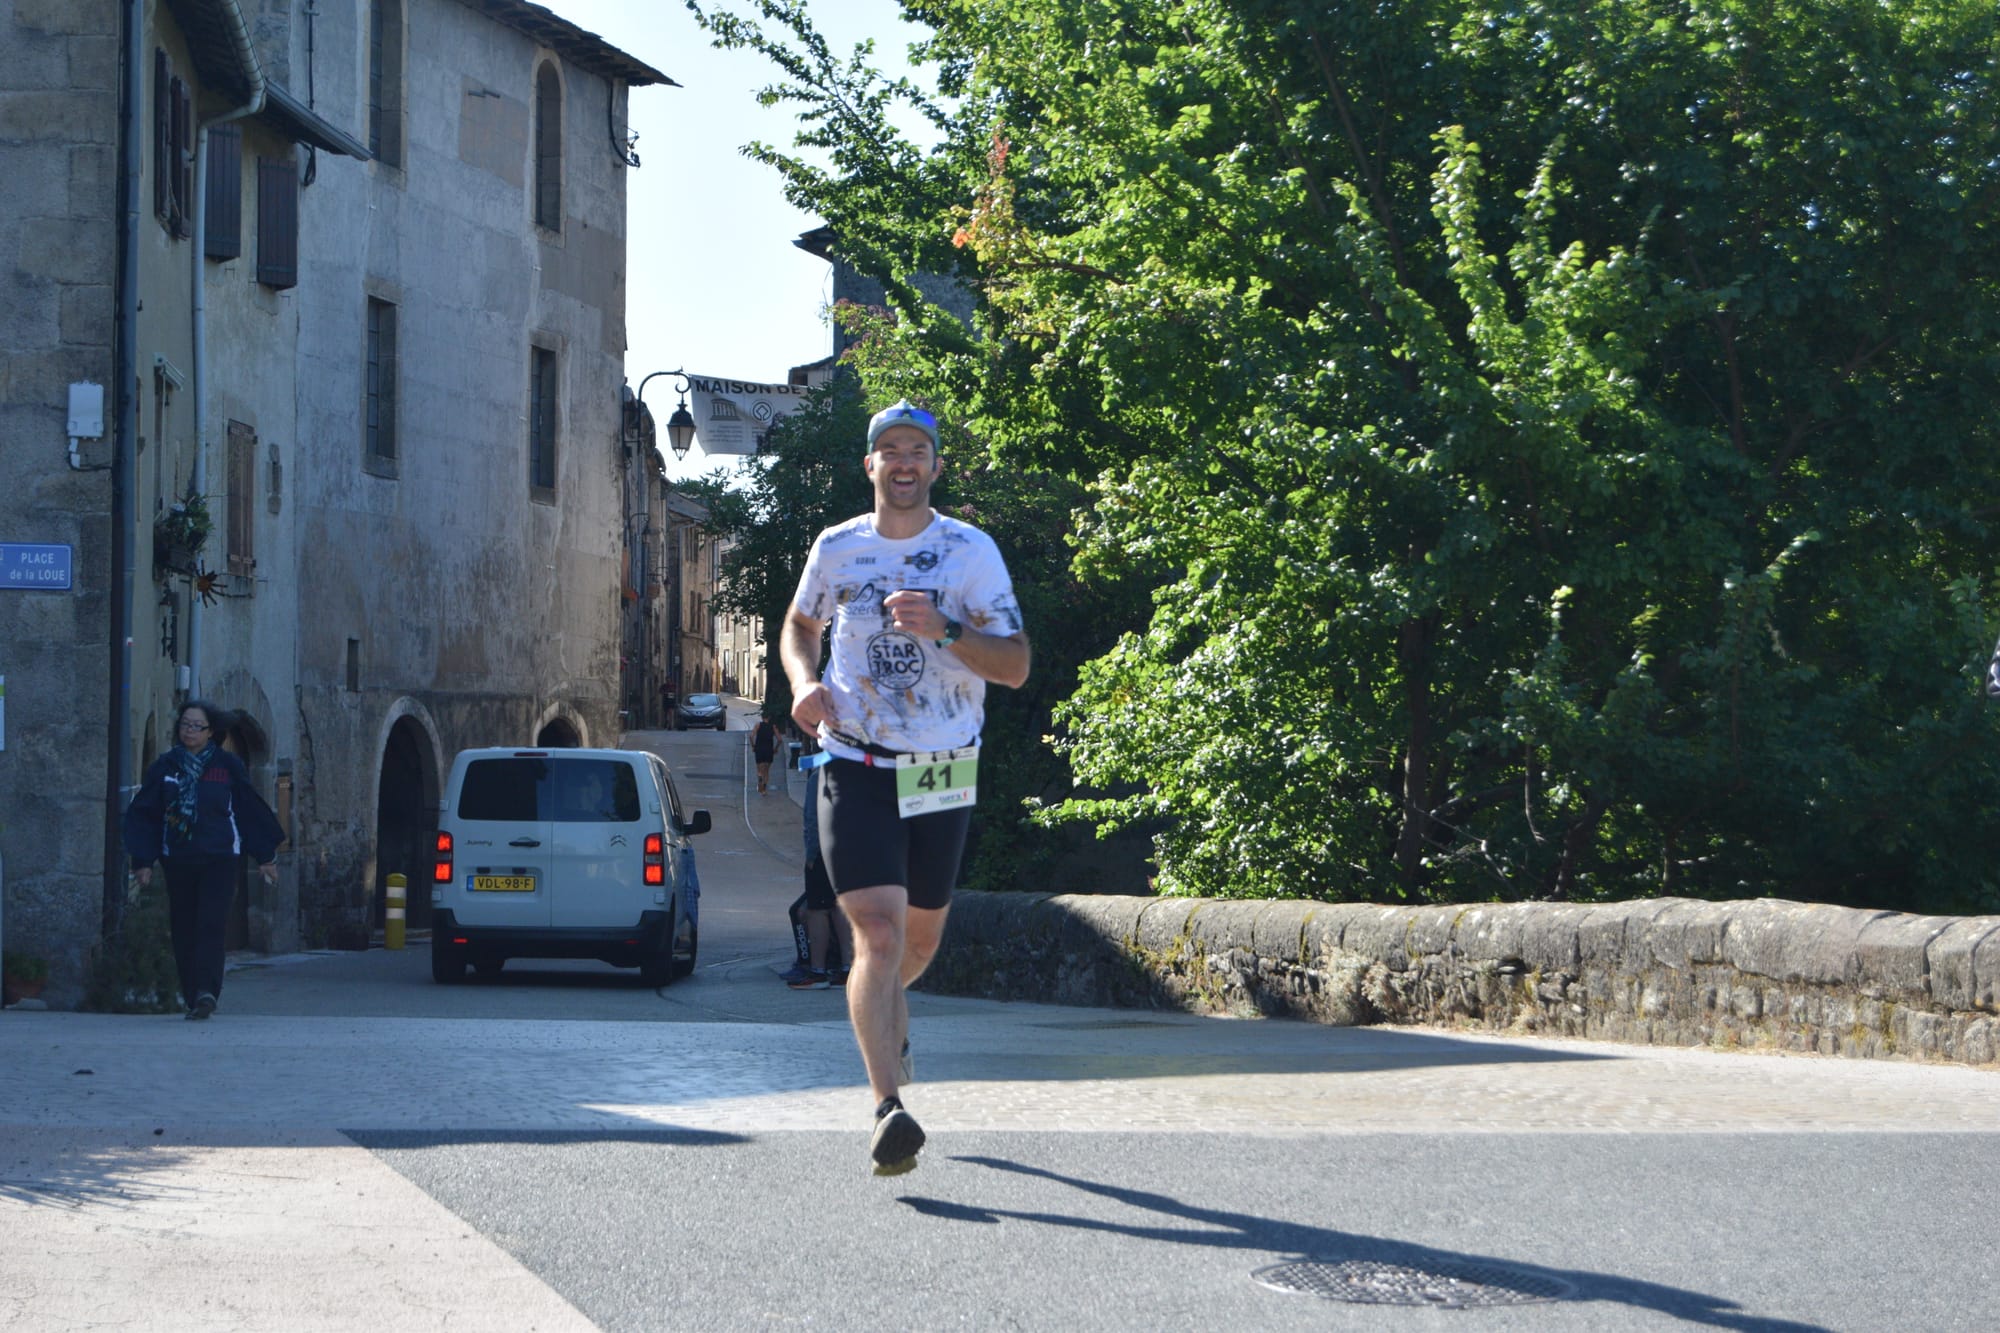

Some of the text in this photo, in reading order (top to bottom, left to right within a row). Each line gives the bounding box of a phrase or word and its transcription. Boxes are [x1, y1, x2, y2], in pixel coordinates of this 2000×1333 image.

[696, 380, 771, 394] MAISON
[777, 385, 801, 395] DE
[21, 552, 54, 564] PLACE
[10, 569, 65, 580] de la LOUE
[872, 643, 917, 658] STAR
[872, 660, 920, 674] TROC
[917, 764, 951, 791] 41
[477, 878, 531, 889] VDL-98-F
